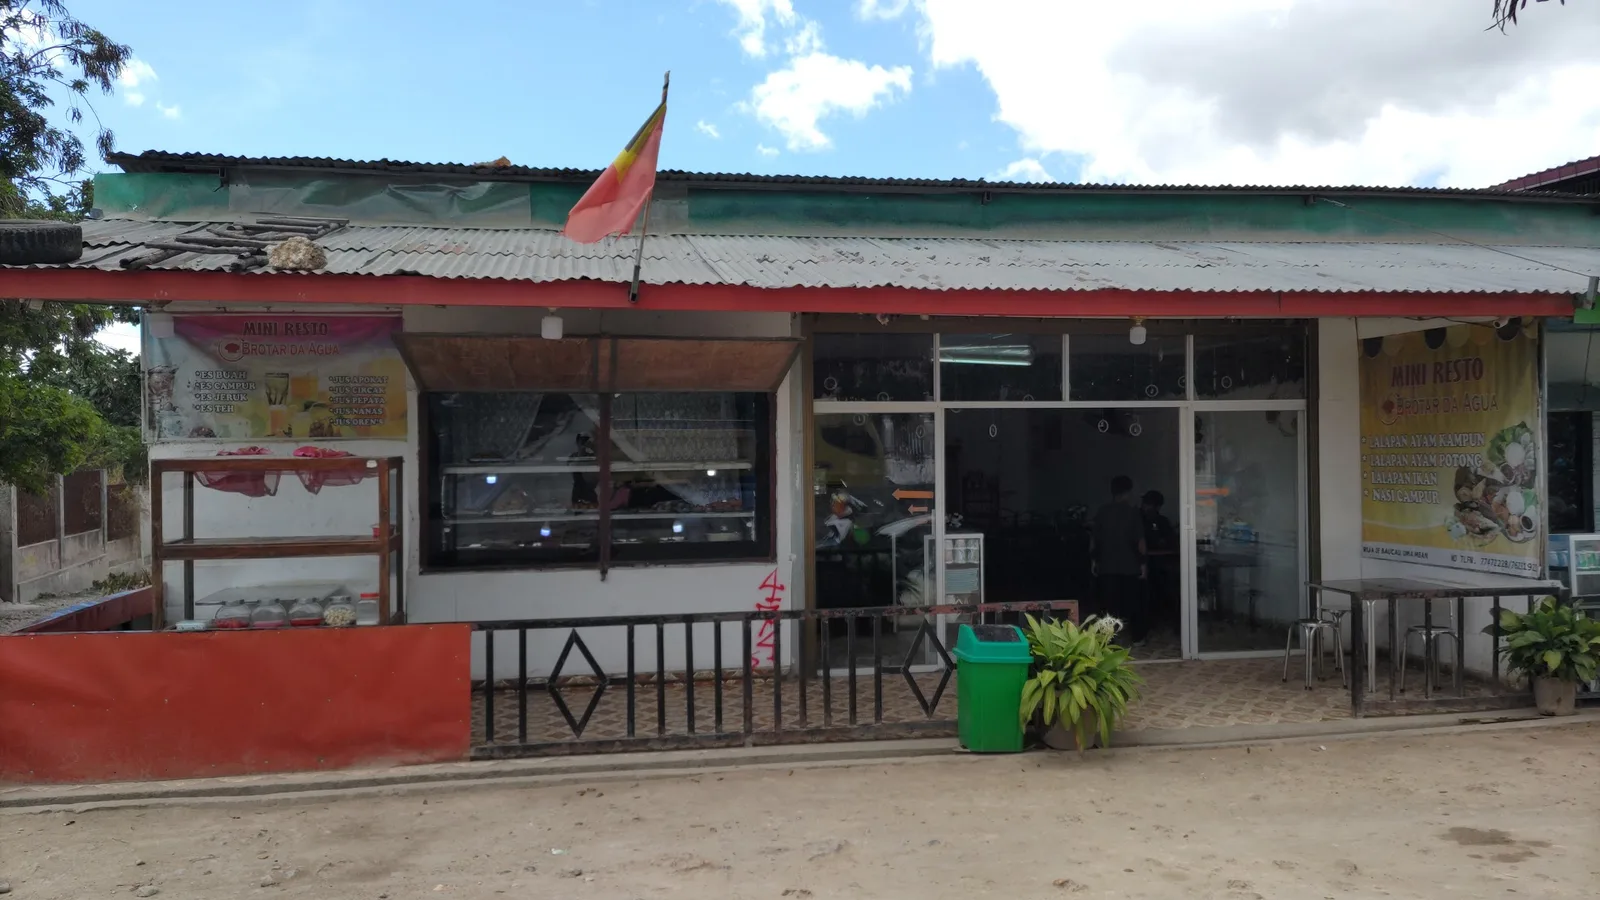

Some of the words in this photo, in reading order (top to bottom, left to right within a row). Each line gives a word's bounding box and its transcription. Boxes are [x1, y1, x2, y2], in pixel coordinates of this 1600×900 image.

[243, 322, 278, 336] MINI
[285, 322, 328, 336] RESTO
[242, 342, 287, 355] BROTAR
[216, 371, 247, 379] BUAH
[1391, 363, 1426, 387] MINI
[1433, 357, 1484, 384] RESTO
[334, 376, 350, 384] JUS
[214, 382, 256, 390] CAMPUR
[334, 386, 350, 394] JUS
[214, 393, 248, 401] JERUK
[214, 404, 235, 413] TEH
[334, 407, 350, 415] JUS
[352, 407, 383, 415] NANAS
[1397, 397, 1440, 416] BROTAR
[334, 418, 350, 426] JUS
[1369, 434, 1408, 448] LALAPAN
[1410, 433, 1437, 447] AYAM
[1370, 454, 1408, 467] LALAPAN
[1410, 454, 1437, 467] AYAM
[1439, 453, 1484, 468] POTONG
[1371, 471, 1411, 485] LALAPAN
[1413, 472, 1438, 486] IKAN
[1372, 489, 1395, 502] NASI
[1396, 489, 1441, 504] CAMPUR
